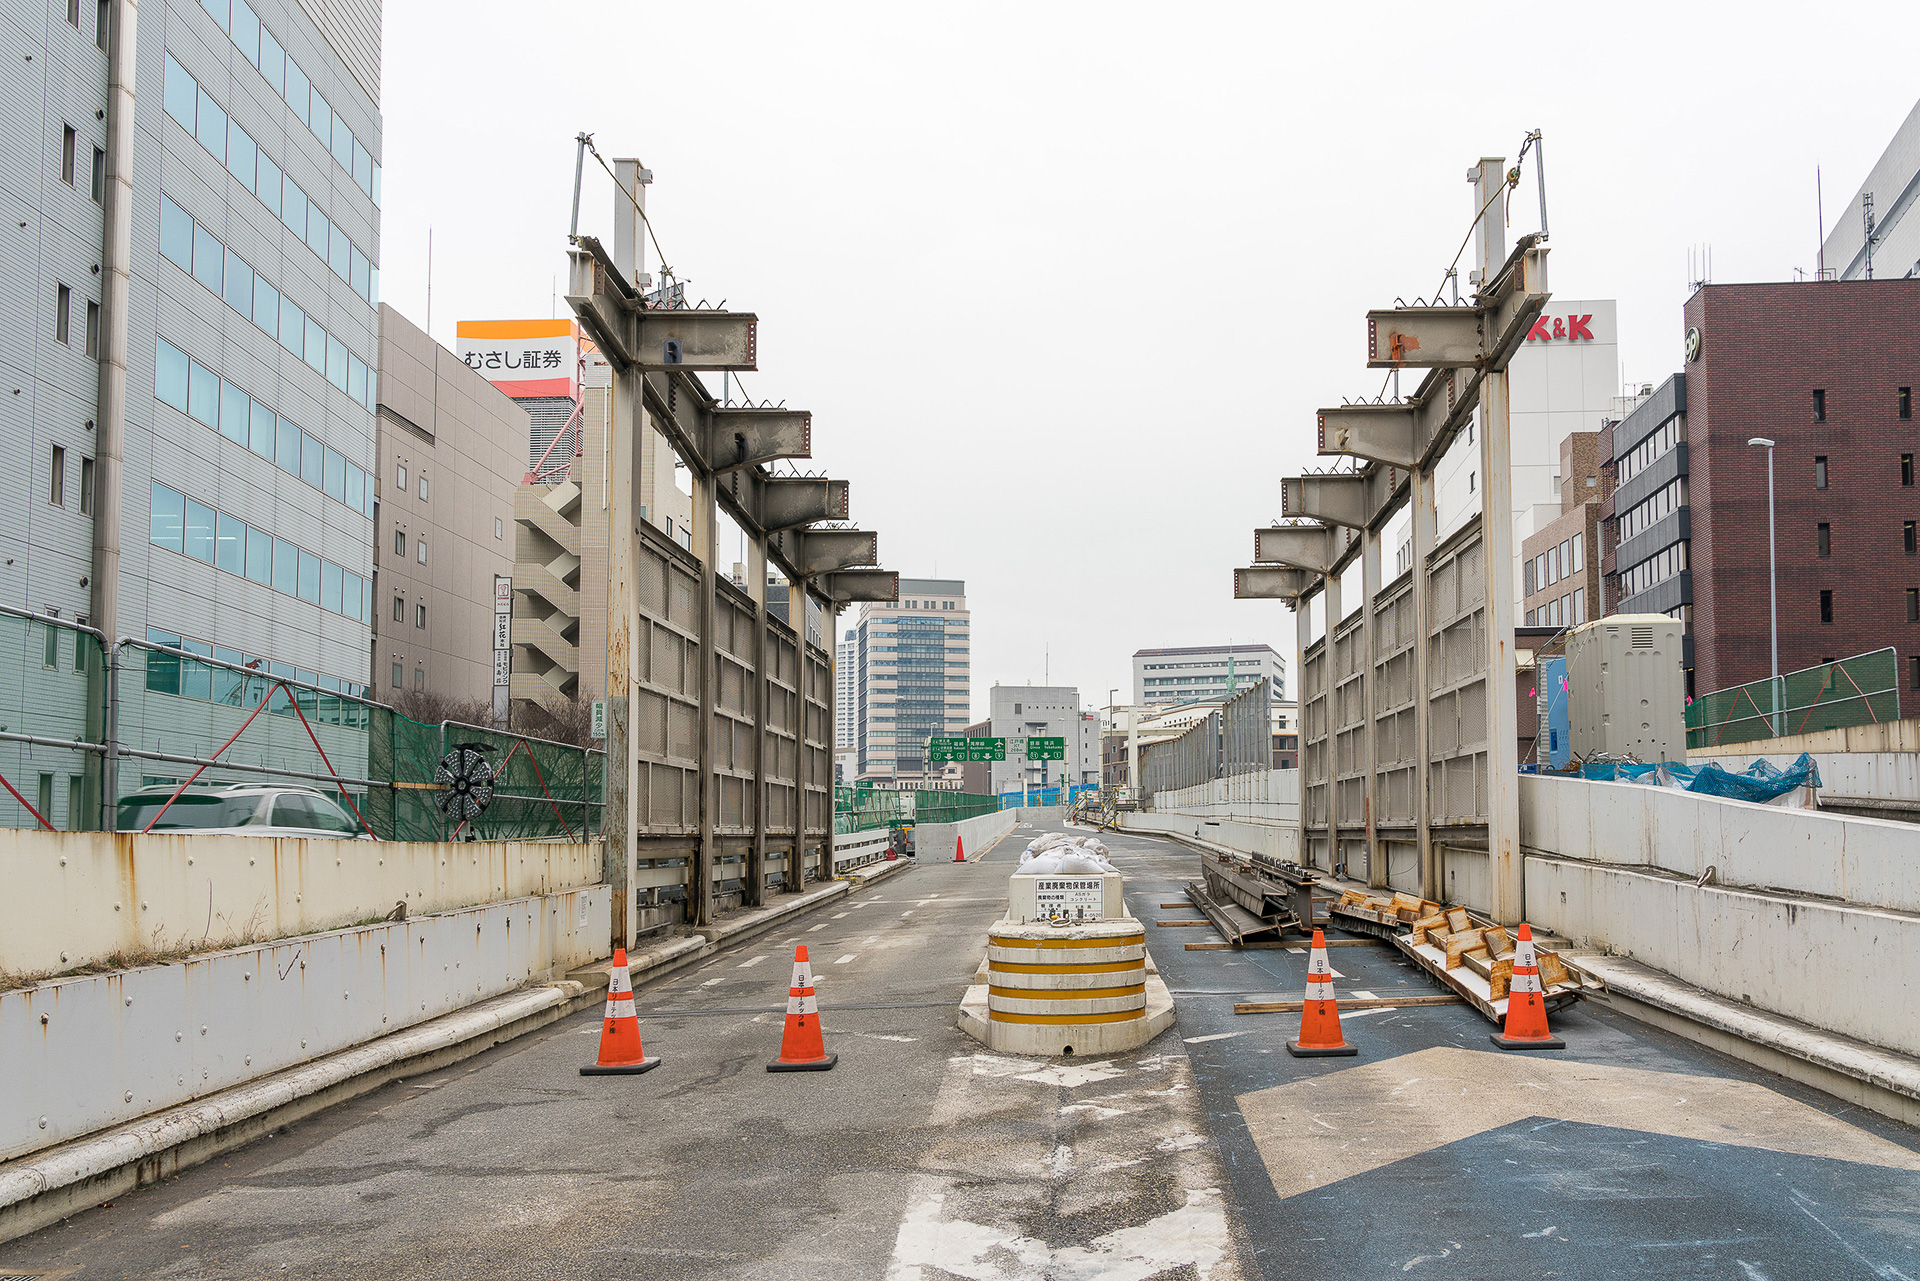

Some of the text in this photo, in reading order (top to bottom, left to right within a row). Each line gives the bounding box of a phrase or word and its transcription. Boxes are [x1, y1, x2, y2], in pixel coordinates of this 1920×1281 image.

[1526, 314, 1594, 341] K&K
[464, 349, 562, 370] むさし証券
[1038, 882, 1099, 890] 産業廃棄物保管場所
